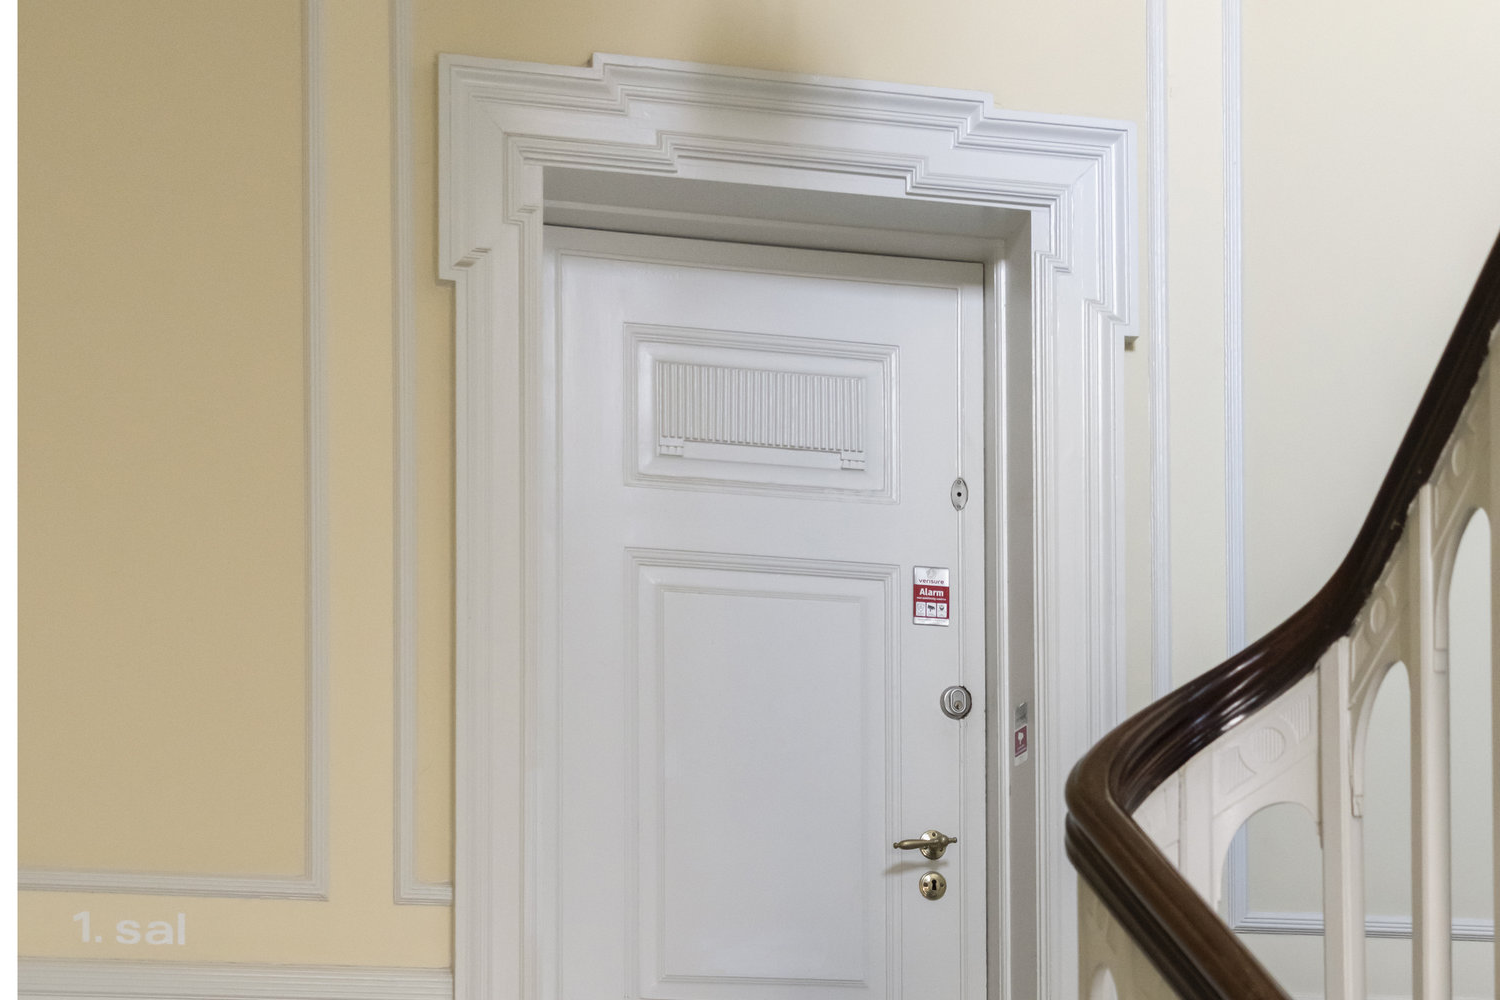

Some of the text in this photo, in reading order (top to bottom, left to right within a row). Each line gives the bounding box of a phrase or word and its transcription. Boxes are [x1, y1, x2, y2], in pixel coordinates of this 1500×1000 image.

[919, 587, 944, 597] Alarm
[72, 911, 186, 945] 1. sal
